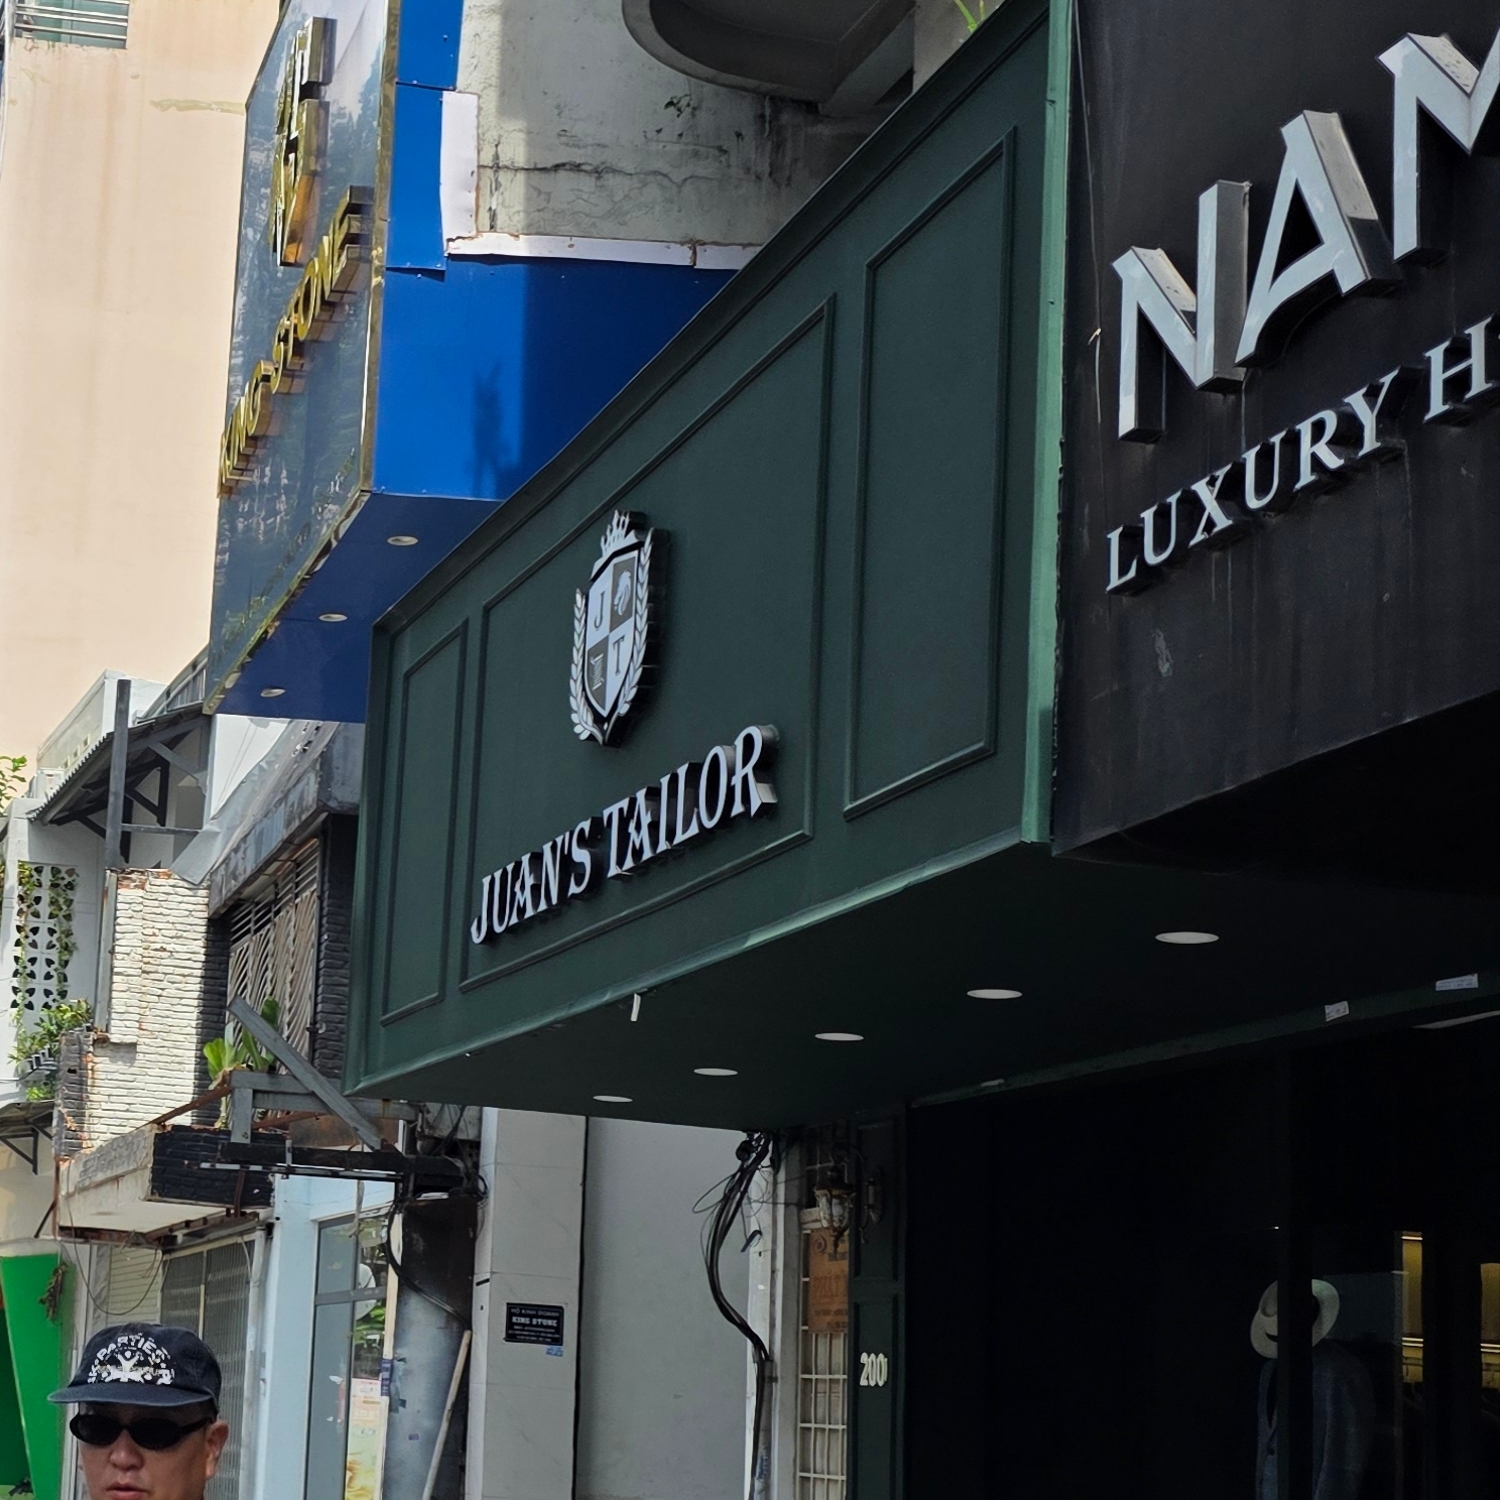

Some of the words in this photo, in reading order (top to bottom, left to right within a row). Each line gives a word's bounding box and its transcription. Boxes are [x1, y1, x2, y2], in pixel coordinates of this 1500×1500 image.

[1106, 367, 1402, 594] LUXURY
[611, 633, 626, 678] T
[471, 816, 594, 945] JUAN'S
[602, 724, 772, 880] TAILOR
[512, 1316, 530, 1325] KING
[532, 1318, 558, 1327] STORE
